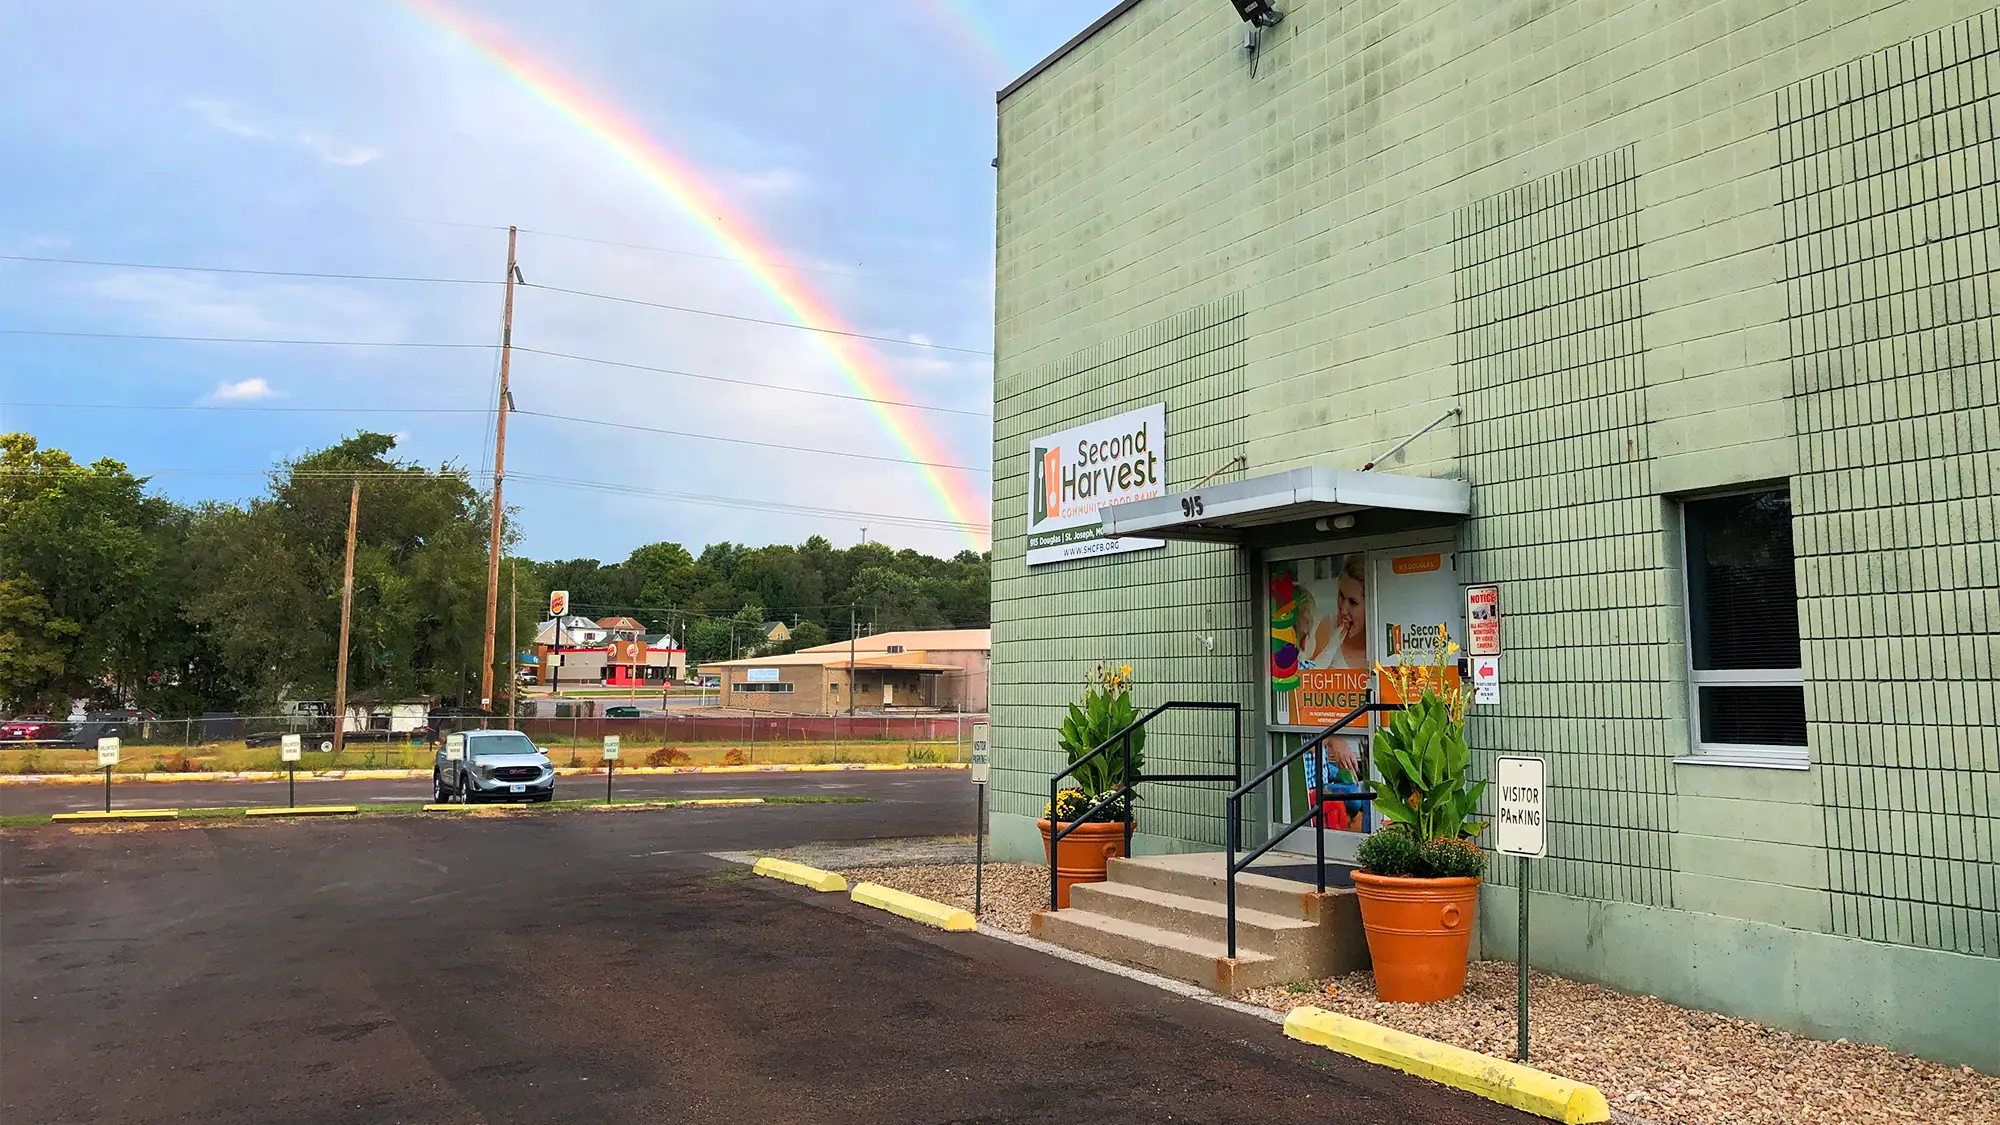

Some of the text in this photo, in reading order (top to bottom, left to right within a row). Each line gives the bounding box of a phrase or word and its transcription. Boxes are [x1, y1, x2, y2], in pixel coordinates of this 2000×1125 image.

[1078, 421, 1147, 468] Second
[1063, 451, 1157, 503] Harvest
[1062, 500, 1106, 518] COMMUNITY
[1182, 496, 1203, 517] 915
[1030, 537, 1039, 547] 915
[1040, 533, 1061, 545] Douglas
[1073, 529, 1094, 540] Joseph,
[1063, 541, 1120, 556] WWW.SHCFB.ORG
[1471, 593, 1496, 603] NOTICE
[1302, 673, 1367, 690] FIGHTING
[1502, 786, 1539, 803] VISITOR
